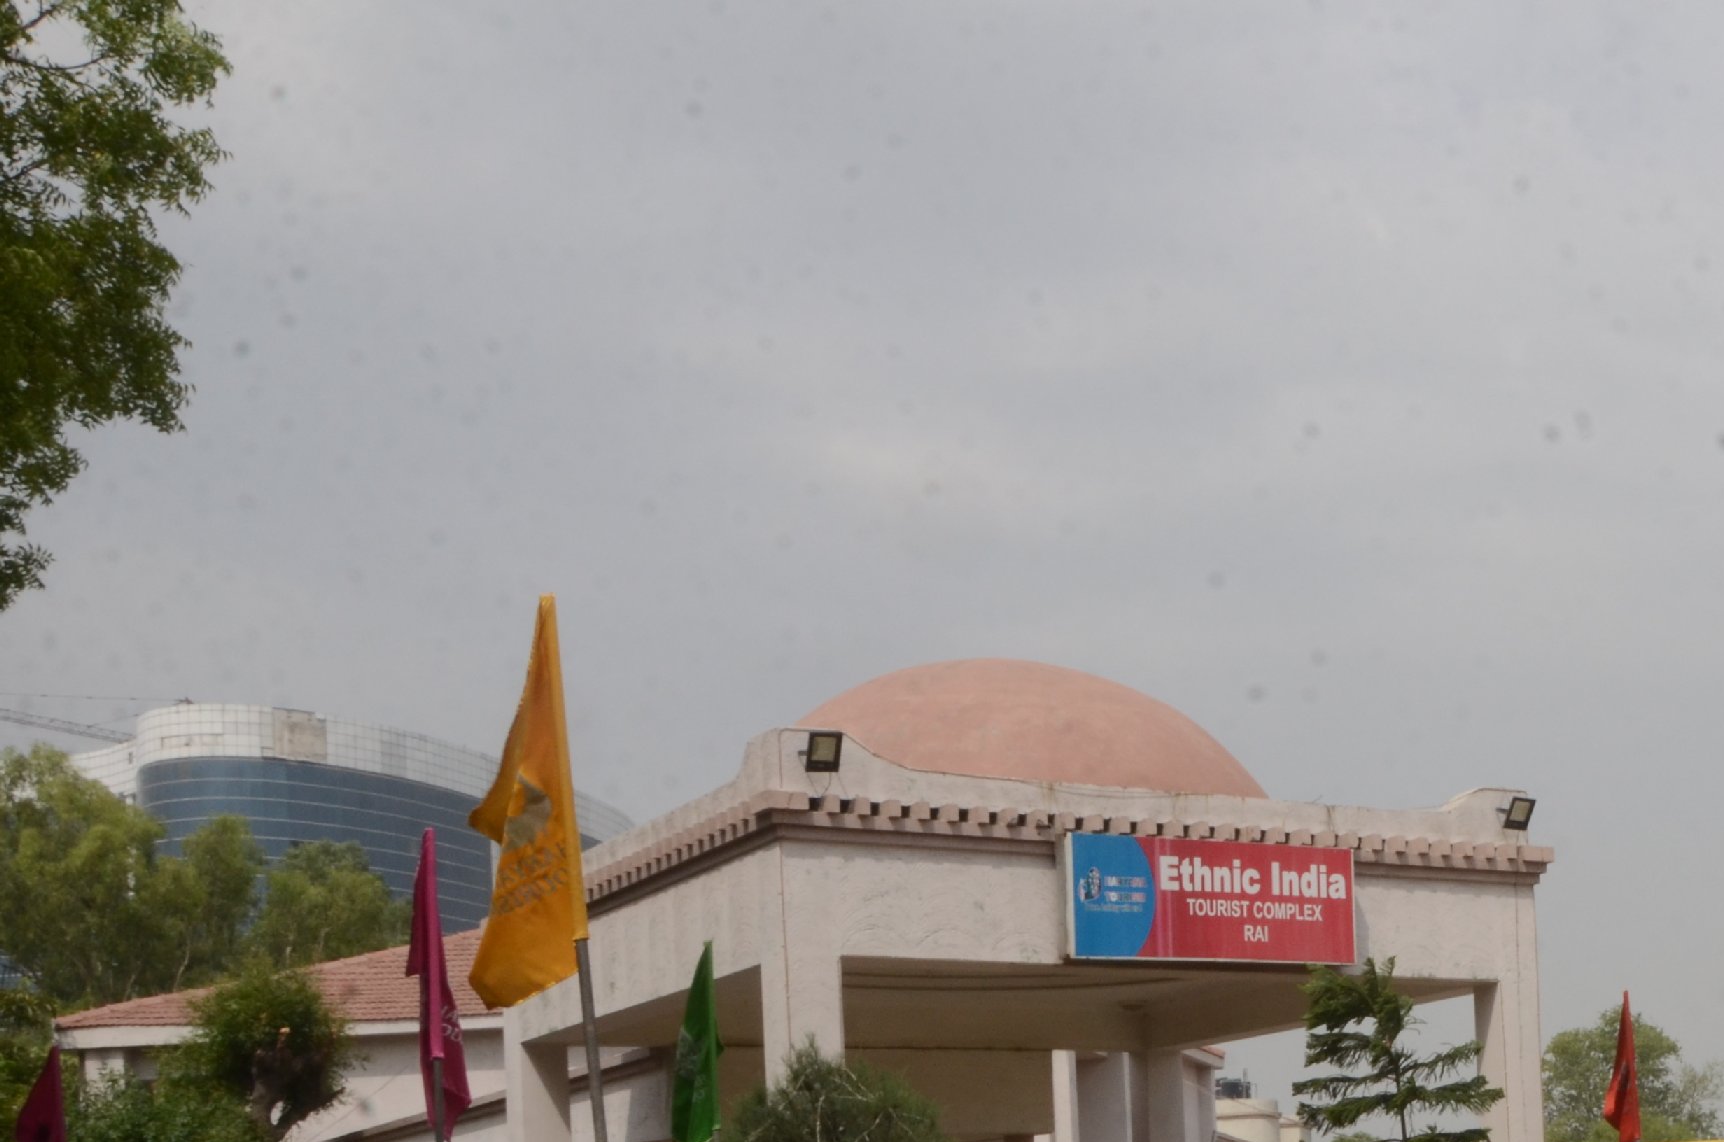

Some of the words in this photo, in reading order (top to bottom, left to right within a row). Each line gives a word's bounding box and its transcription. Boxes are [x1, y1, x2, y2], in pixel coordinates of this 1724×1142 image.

[1159, 855, 1261, 895] Ethnic
[1271, 861, 1347, 899] India
[1186, 898, 1250, 918] TOURIST
[1253, 902, 1323, 922] COMPLEX
[1243, 925, 1269, 942] RAI
